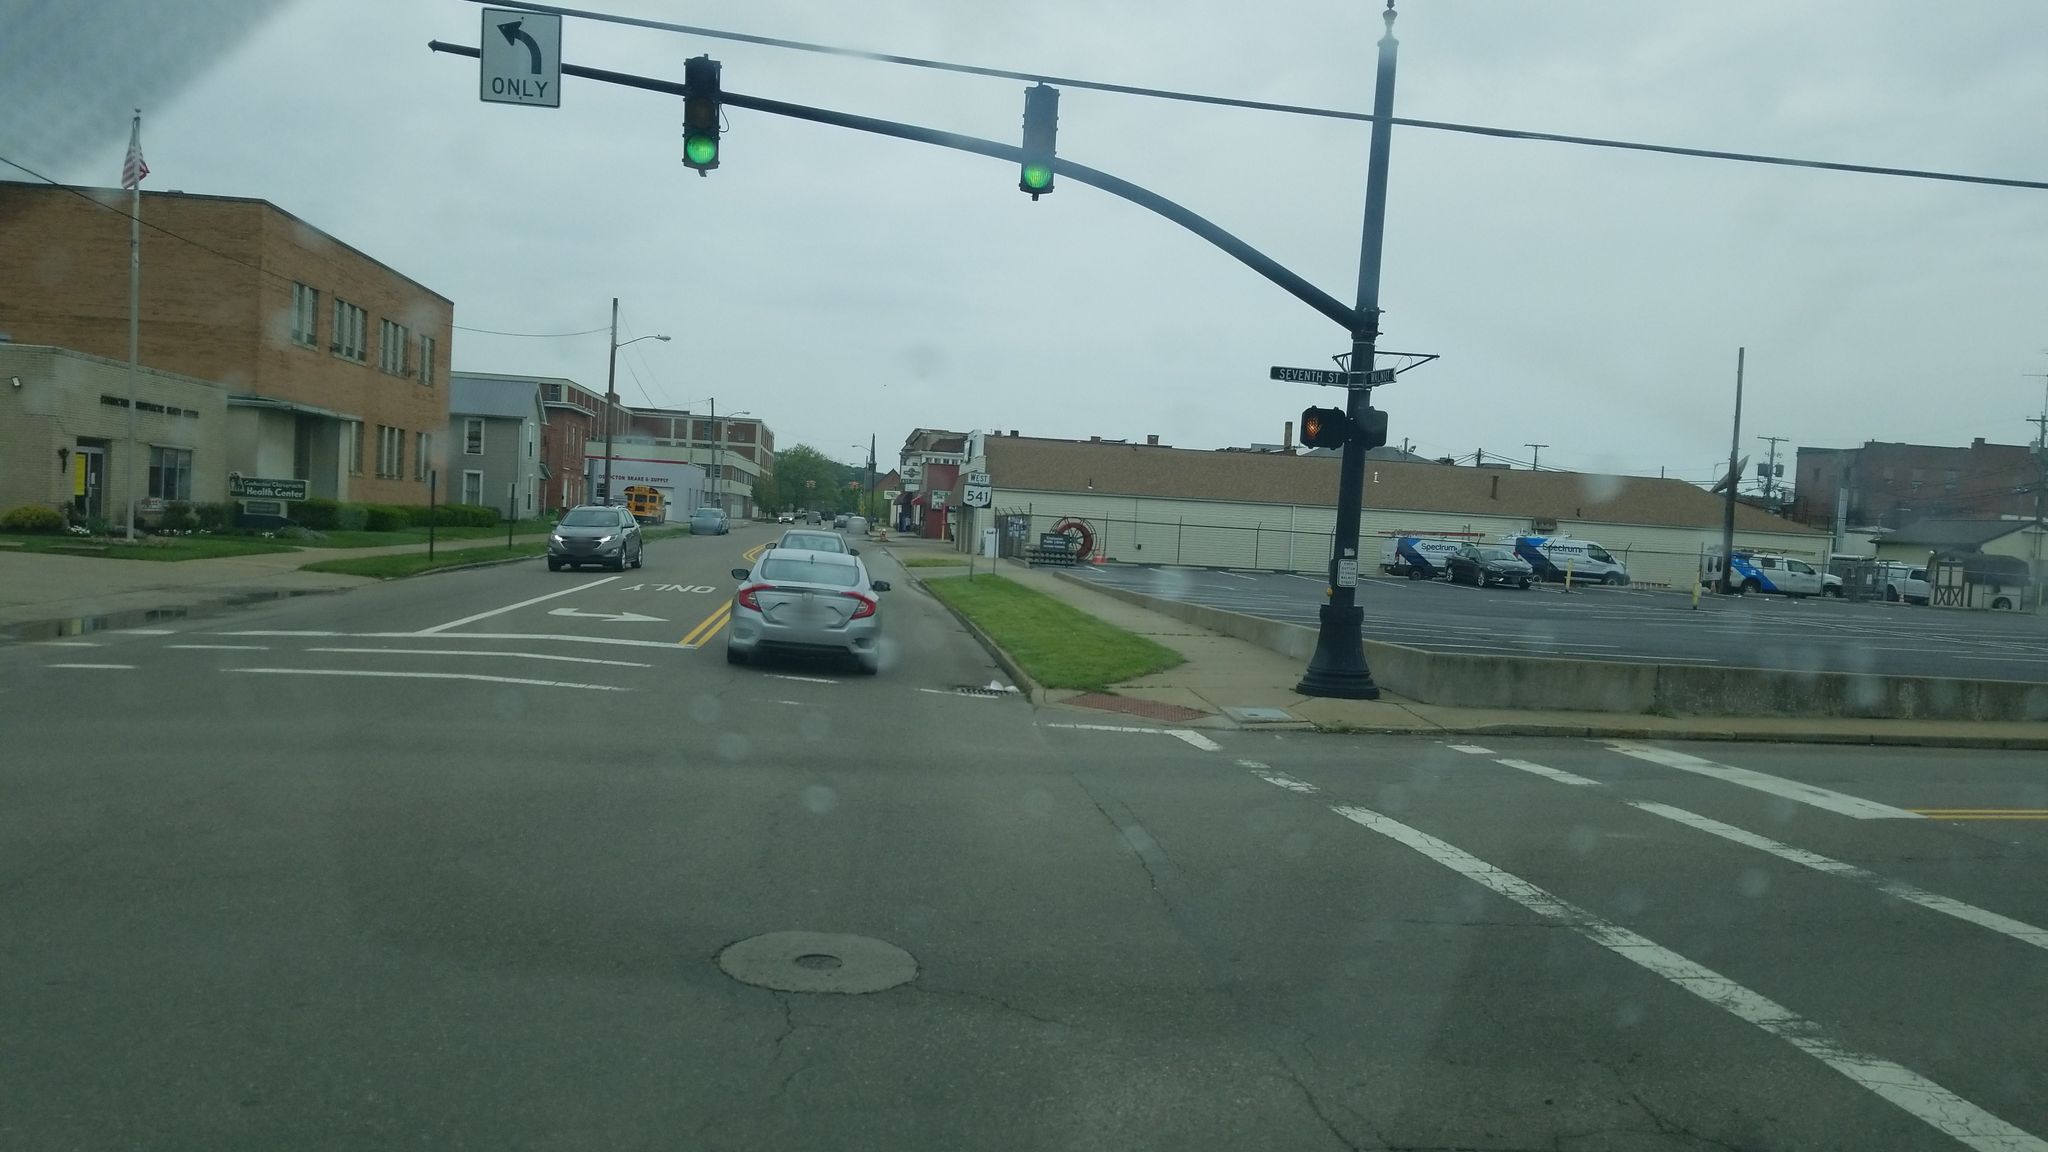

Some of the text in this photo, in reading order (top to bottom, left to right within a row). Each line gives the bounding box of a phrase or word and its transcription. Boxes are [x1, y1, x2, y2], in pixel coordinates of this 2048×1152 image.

[492, 77, 548, 98] ONLY
[1279, 368, 1340, 383] SEVENTH ST
[1371, 370, 1390, 383] WALNUT
[970, 474, 988, 482] WEST
[246, 486, 304, 498] Health Center
[967, 490, 989, 502] 541
[1421, 543, 1457, 551] Spectrum
[1542, 543, 1581, 553] Spectrum
[619, 583, 717, 594] ONLY
